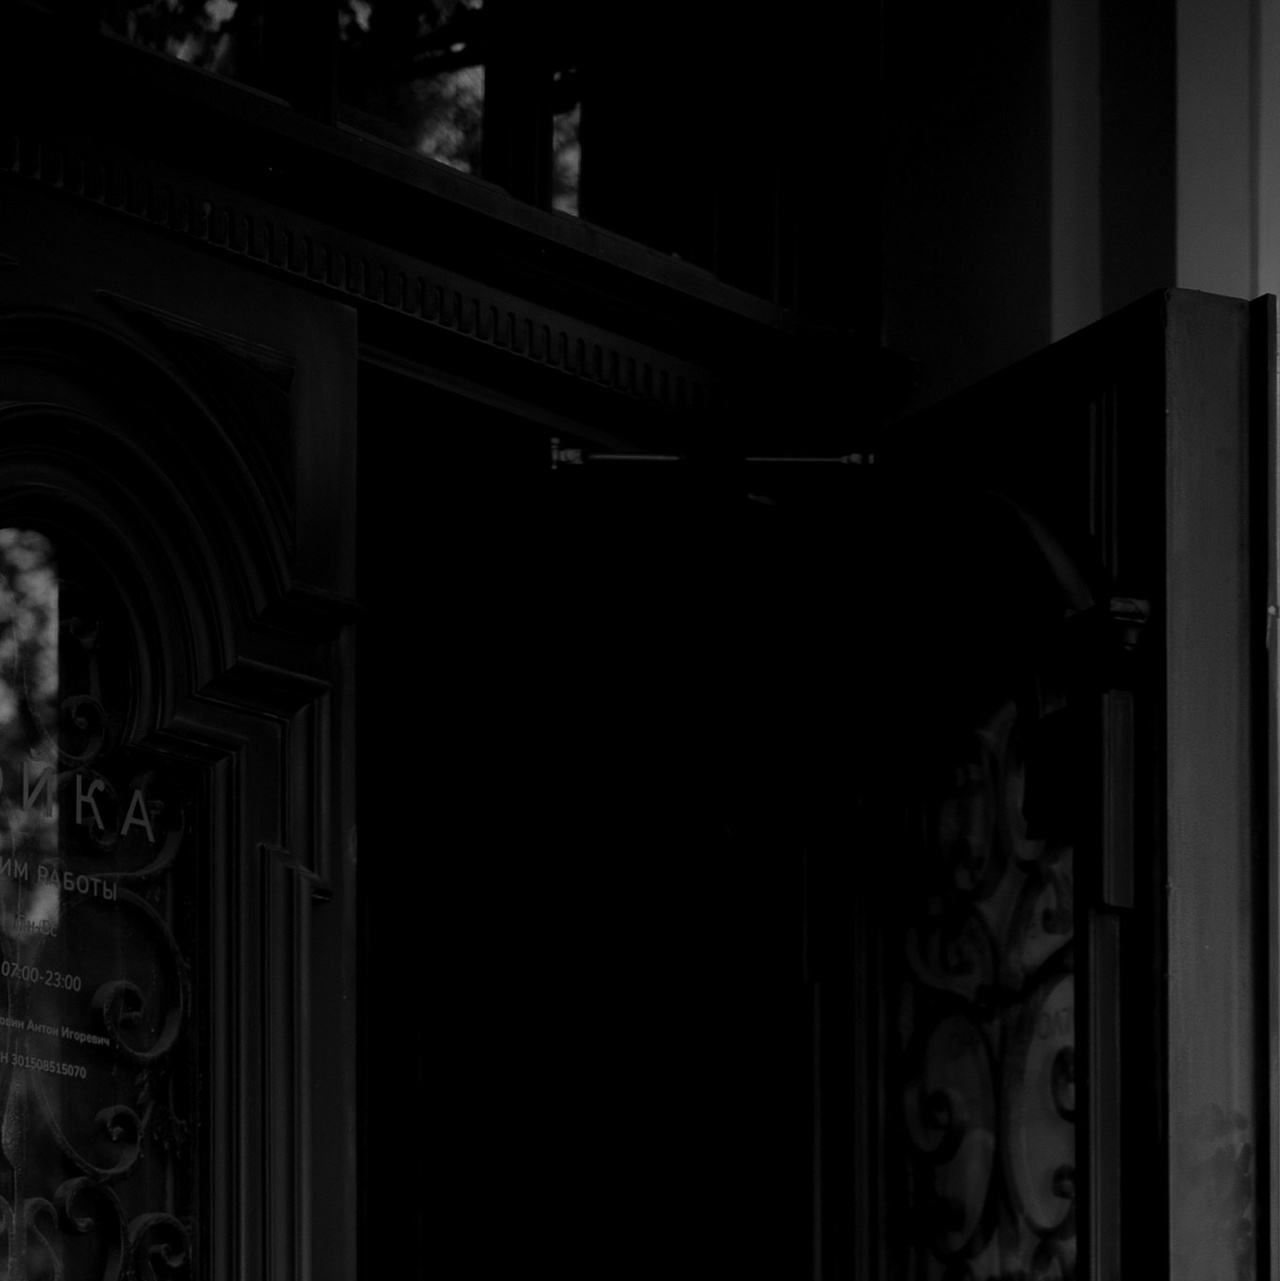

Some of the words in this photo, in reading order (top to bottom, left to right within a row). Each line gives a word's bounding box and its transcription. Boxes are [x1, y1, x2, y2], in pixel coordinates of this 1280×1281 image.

[0, 748, 155, 843] ЙКА
[38, 865, 117, 901] РАБОТЫ
[1, 961, 82, 992] 07:00-23:00
[27, 1019, 59, 1037] Антон
[61, 1026, 110, 1047] Игоревич
[11, 1053, 87, 1079] 301508515070
